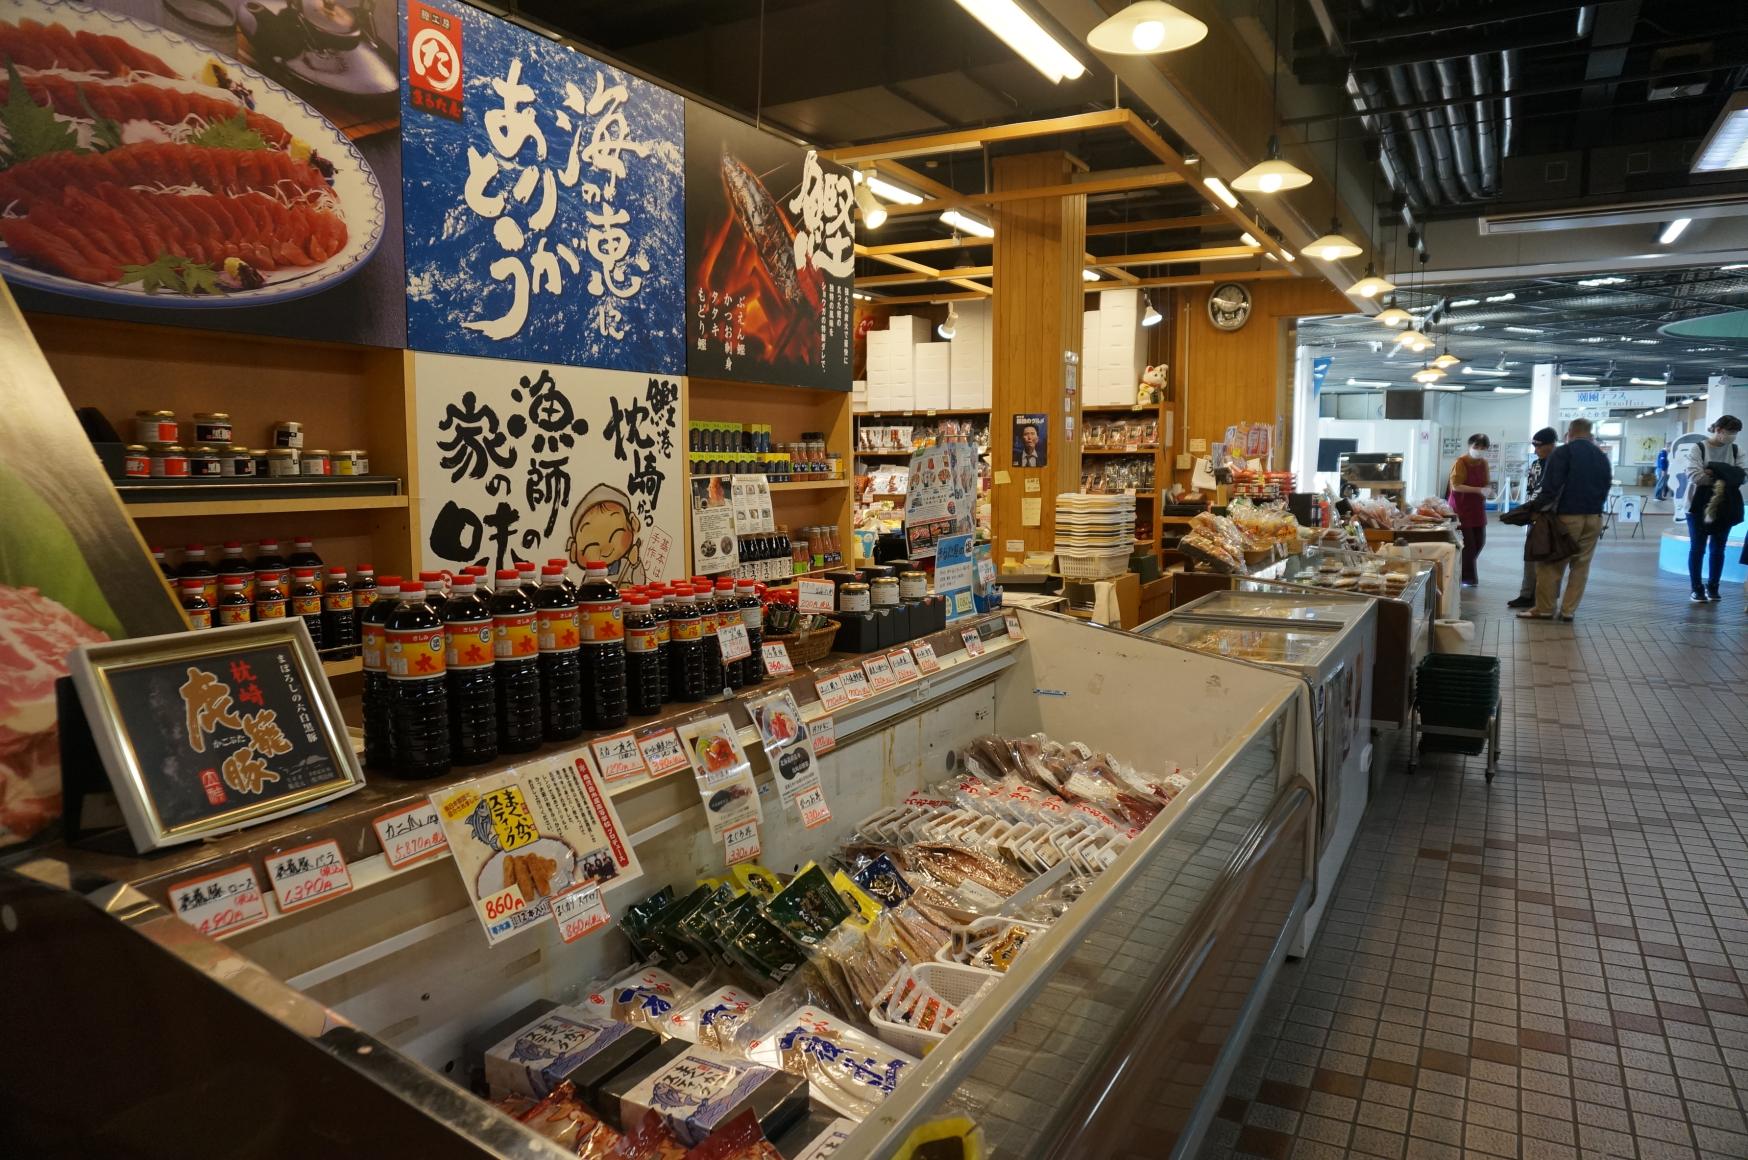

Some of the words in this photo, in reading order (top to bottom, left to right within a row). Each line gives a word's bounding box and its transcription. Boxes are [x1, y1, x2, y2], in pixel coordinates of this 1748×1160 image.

[462, 57, 580, 341] ありがとう
[789, 149, 855, 279] 鰹
[711, 290, 720, 337] タタキ
[724, 293, 733, 371] かつお刺身
[603, 396, 666, 528] 枕崎から
